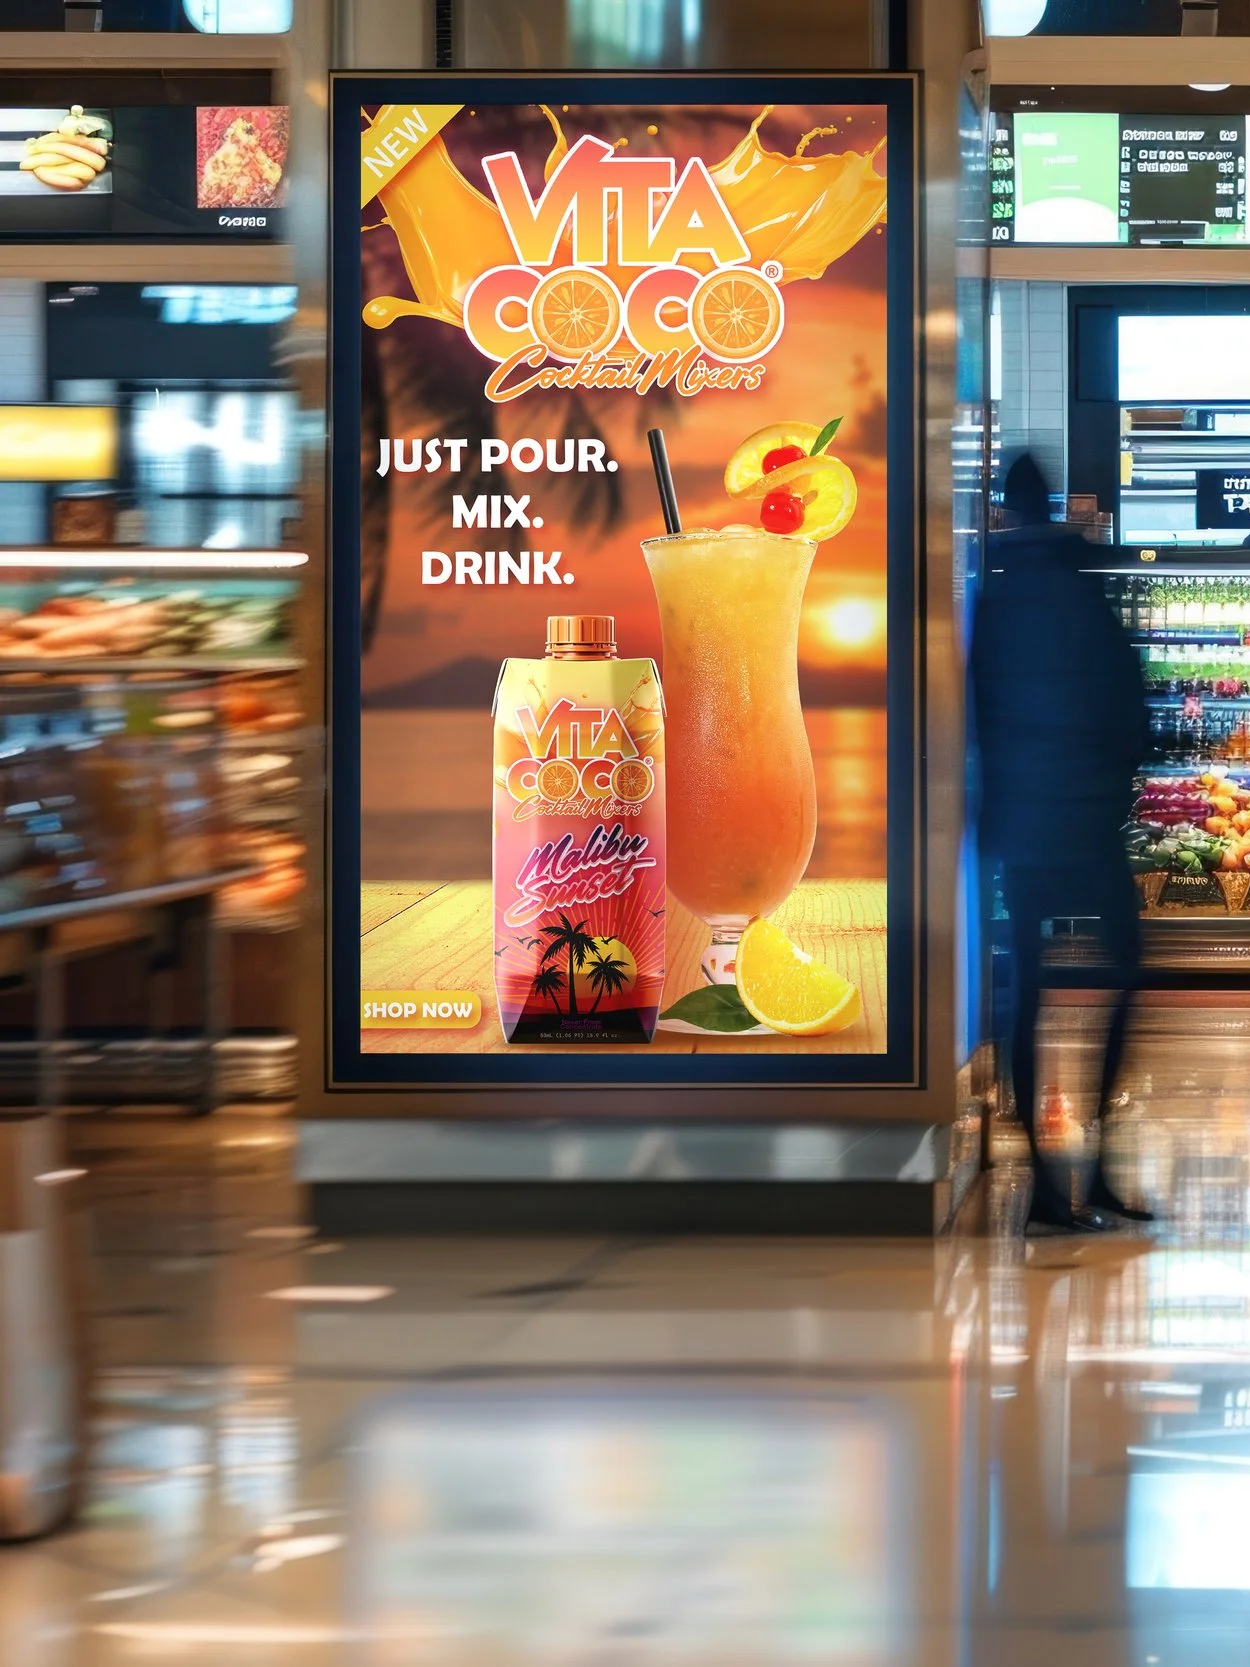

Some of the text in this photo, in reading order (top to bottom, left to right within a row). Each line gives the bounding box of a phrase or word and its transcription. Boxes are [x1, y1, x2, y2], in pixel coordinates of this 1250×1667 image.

[363, 107, 428, 179] NEW
[481, 134, 751, 267] VITA
[484, 343, 766, 403] Cocktail Mixers
[376, 438, 619, 477] JUST POUR.
[452, 495, 544, 529] MIX.
[422, 551, 575, 585] DRINK.
[514, 698, 639, 759] VITA
[512, 793, 642, 822] Cocktail Mixers
[516, 823, 648, 889] Malibu
[504, 856, 656, 927] Sunset
[363, 1001, 473, 1019] SHOP NOW
